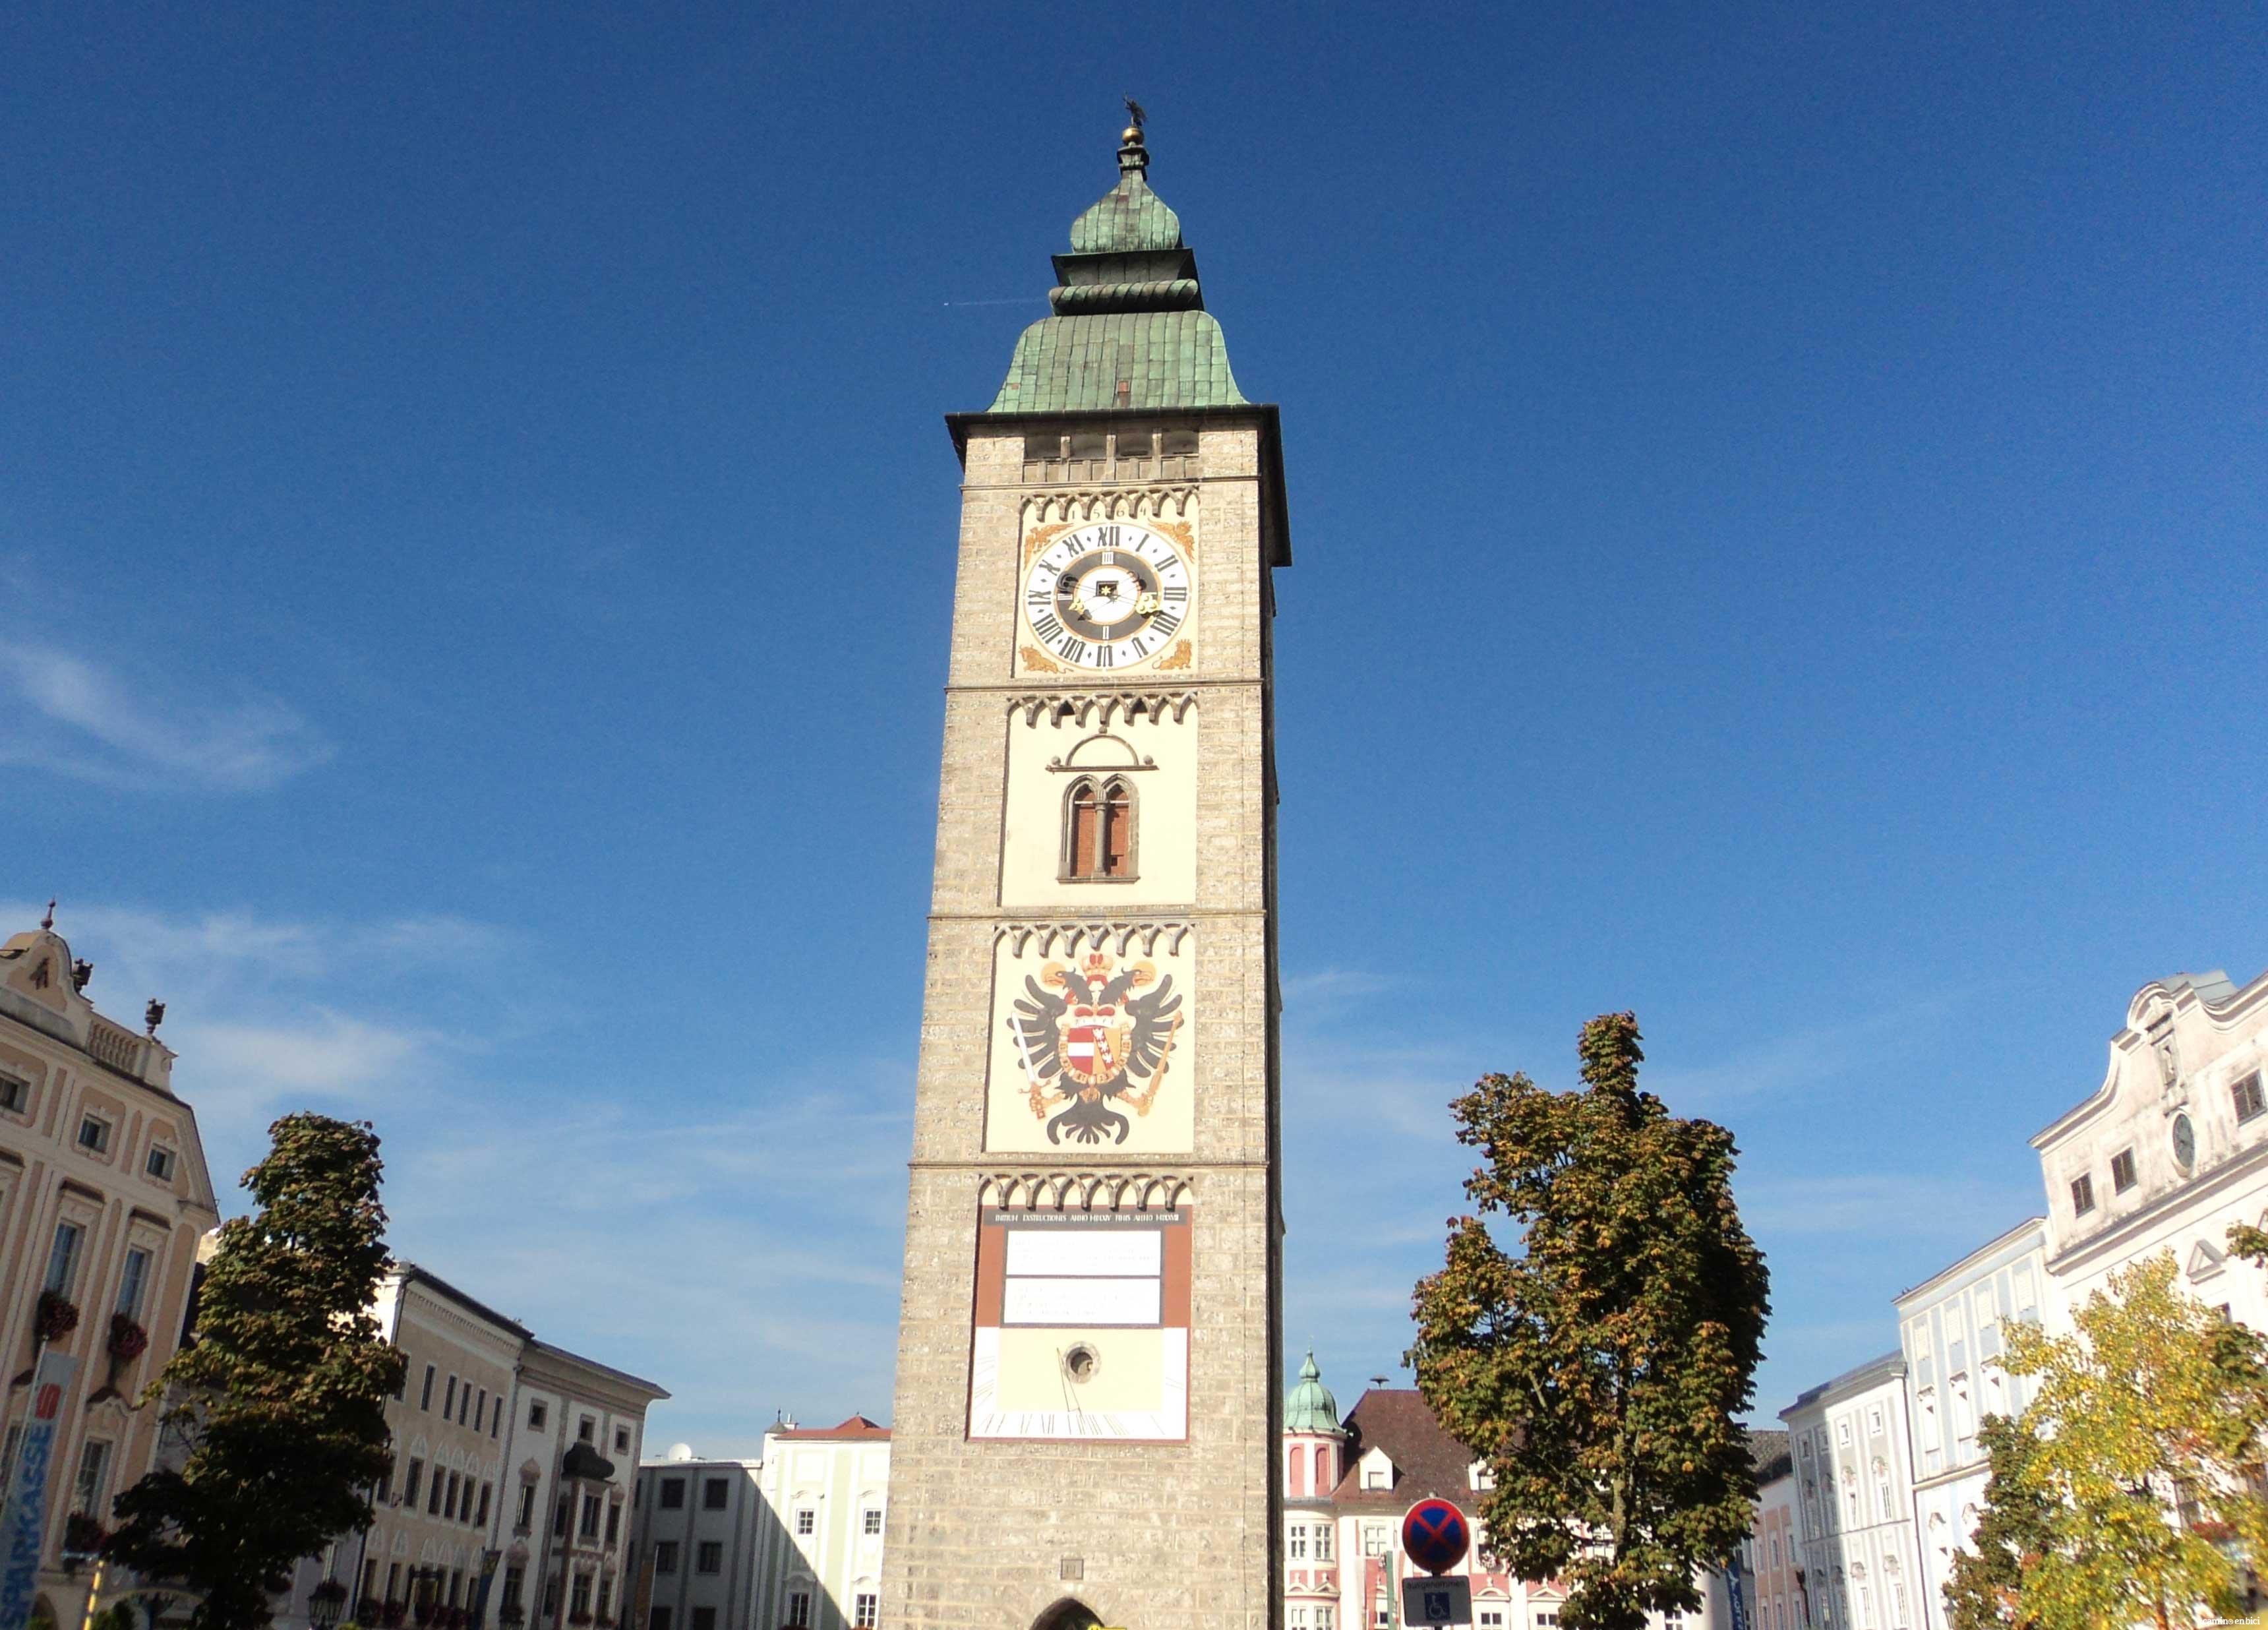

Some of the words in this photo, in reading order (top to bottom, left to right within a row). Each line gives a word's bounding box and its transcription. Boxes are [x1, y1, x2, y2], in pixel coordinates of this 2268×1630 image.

[1062, 533, 1085, 557] XI
[1097, 526, 1120, 547] XII
[1038, 559, 1061, 576] X
[1407, 1580, 1466, 1589] ausgenommen
